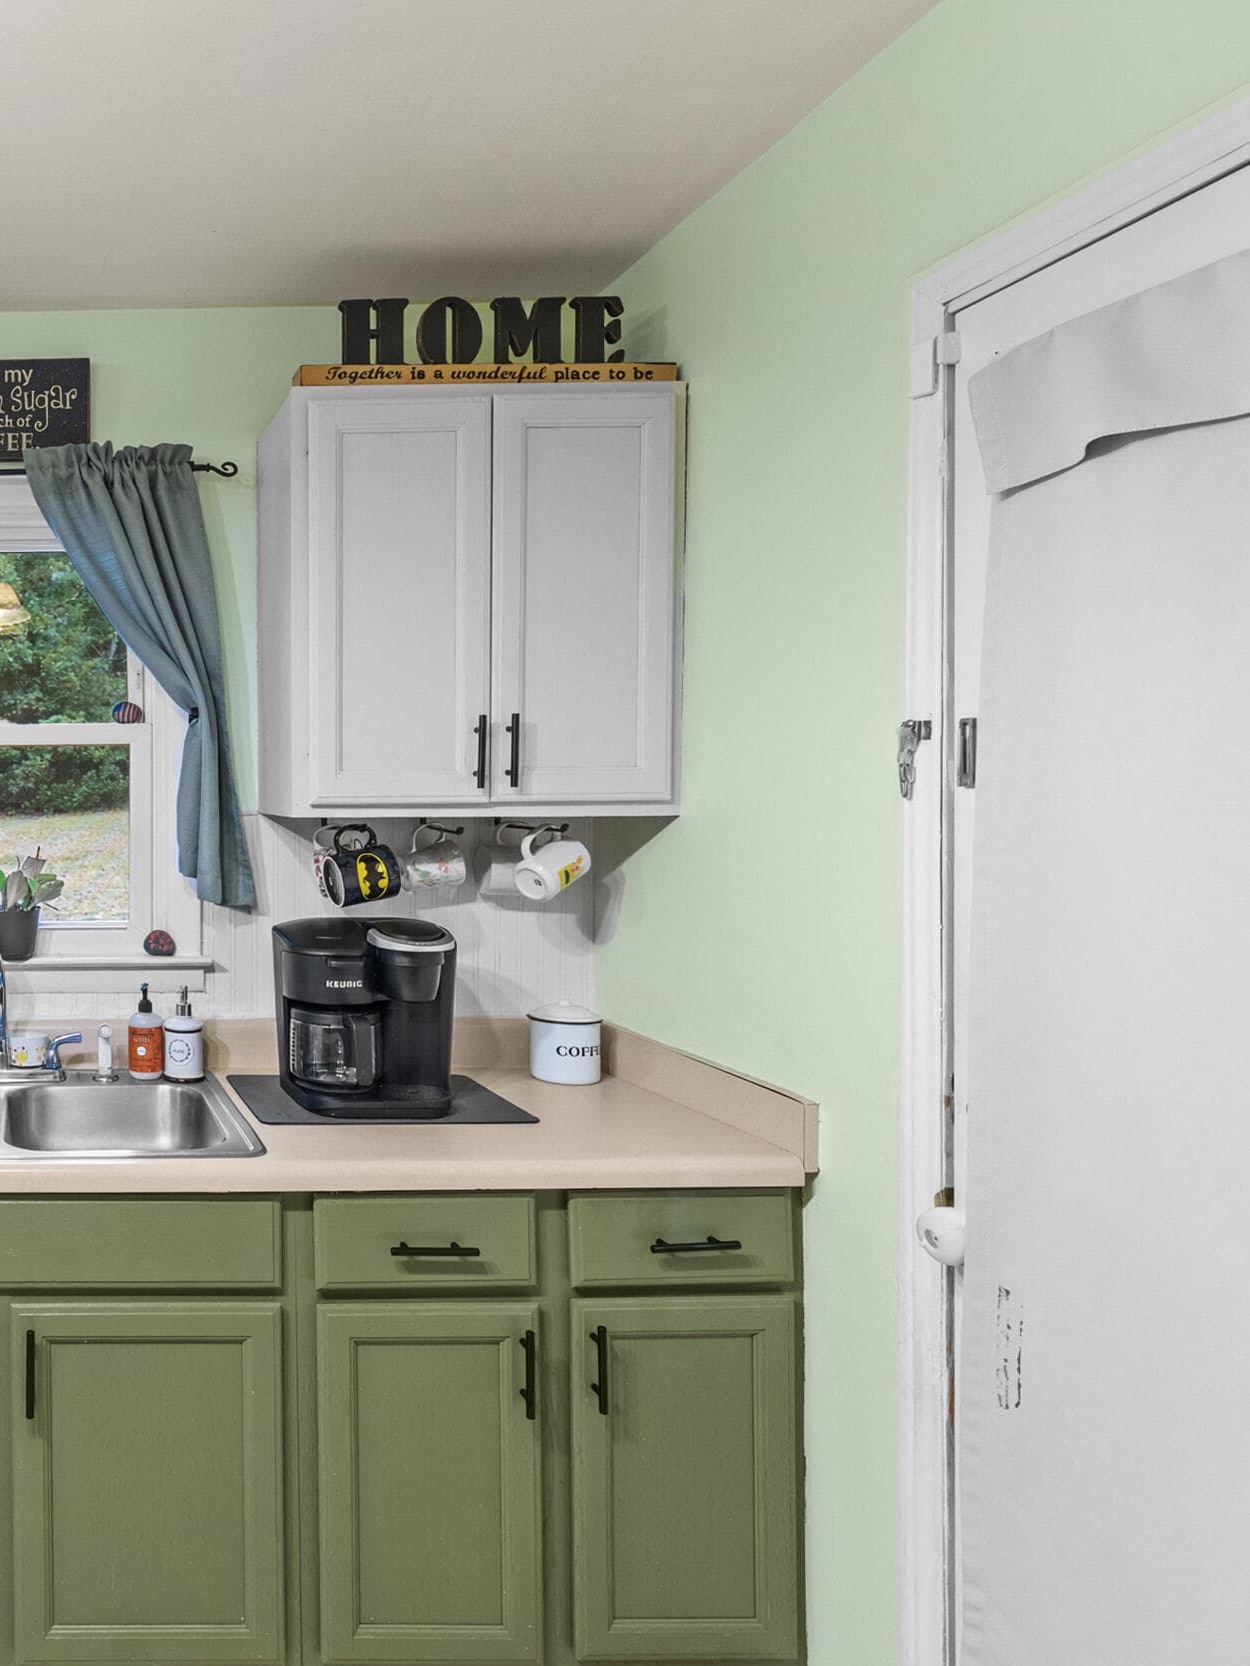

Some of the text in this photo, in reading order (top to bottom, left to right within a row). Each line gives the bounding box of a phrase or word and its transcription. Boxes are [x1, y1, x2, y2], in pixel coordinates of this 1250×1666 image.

[338, 296, 625, 365] HOME
[4, 369, 33, 386] my
[325, 366, 654, 383] Together is a wonderful place to be
[16, 415, 33, 428] of
[556, 1045, 599, 1057] COFF
